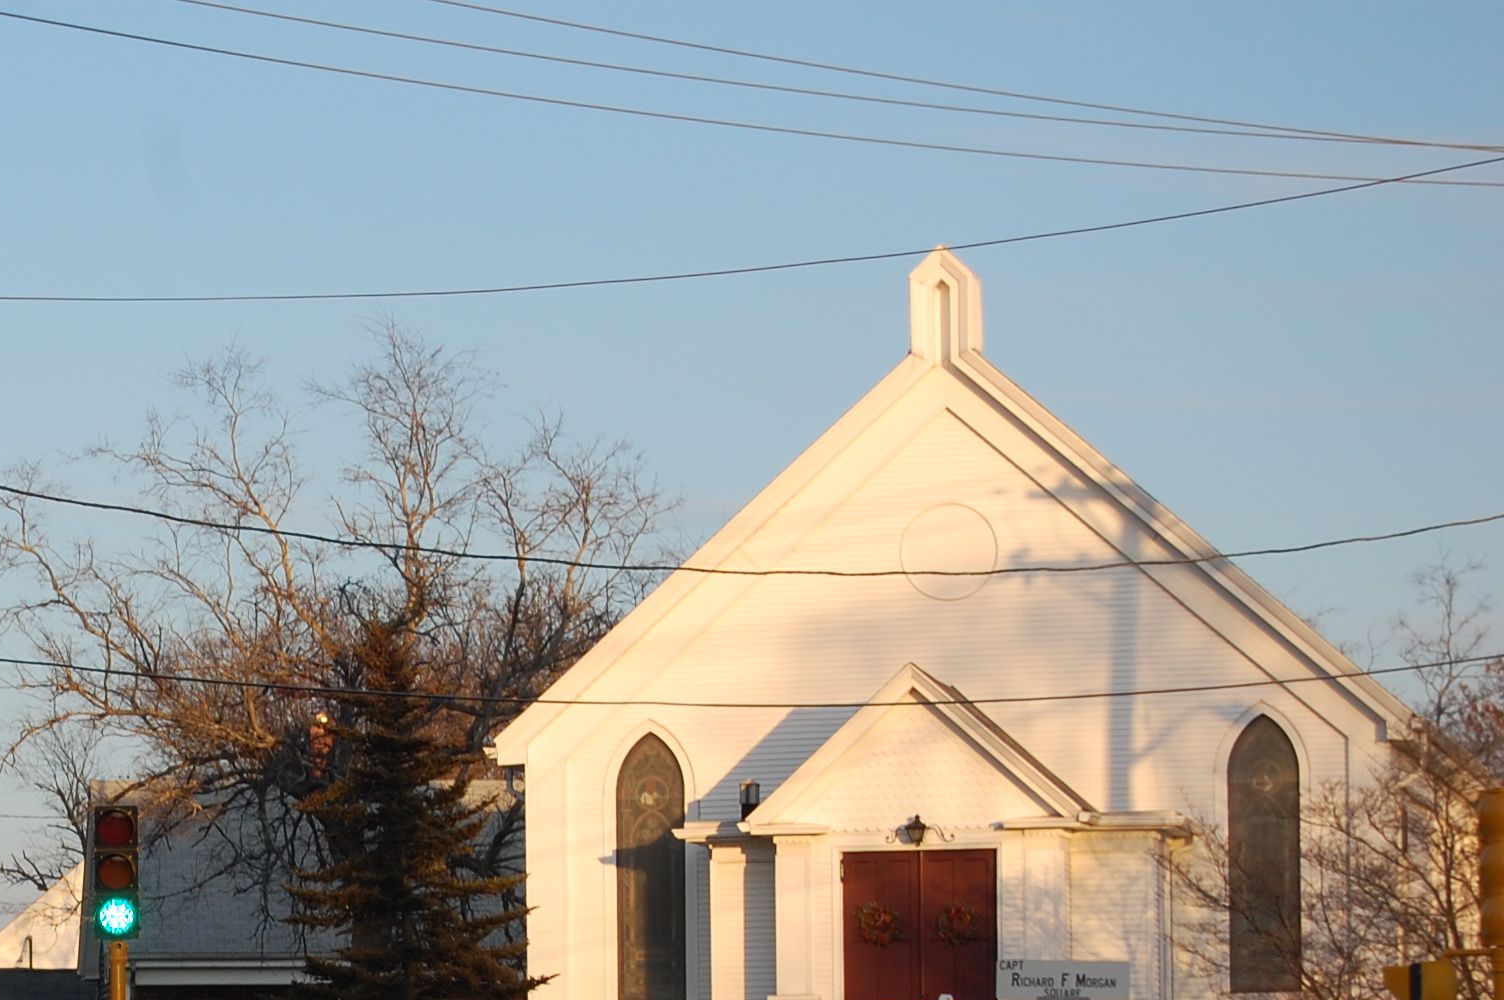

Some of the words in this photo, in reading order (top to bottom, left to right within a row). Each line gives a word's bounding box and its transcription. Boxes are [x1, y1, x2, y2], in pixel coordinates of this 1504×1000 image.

[999, 960, 1023, 970] CAPT
[1061, 973, 1069, 987] F
[1044, 988, 1082, 998] SQUARE
